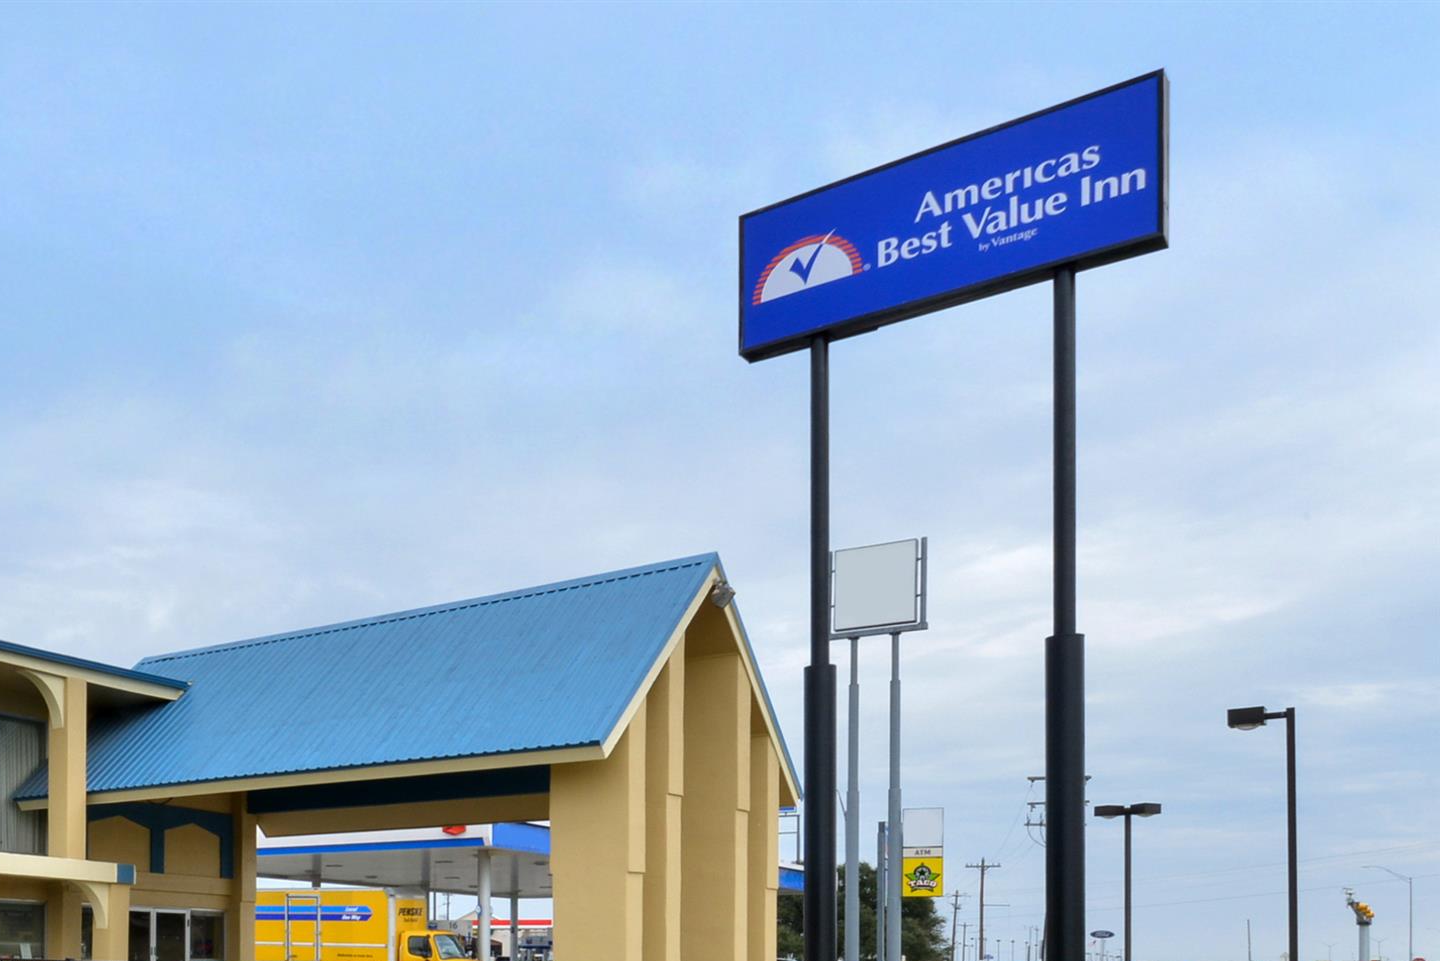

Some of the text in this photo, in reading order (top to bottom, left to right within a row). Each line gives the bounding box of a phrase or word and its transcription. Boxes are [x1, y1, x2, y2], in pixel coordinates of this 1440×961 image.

[914, 144, 1101, 225] Americas
[877, 167, 1147, 269] Best Value Inn
[978, 227, 1039, 253] by Vantage
[908, 879, 937, 888] TACO
[398, 907, 423, 917] PENSKE
